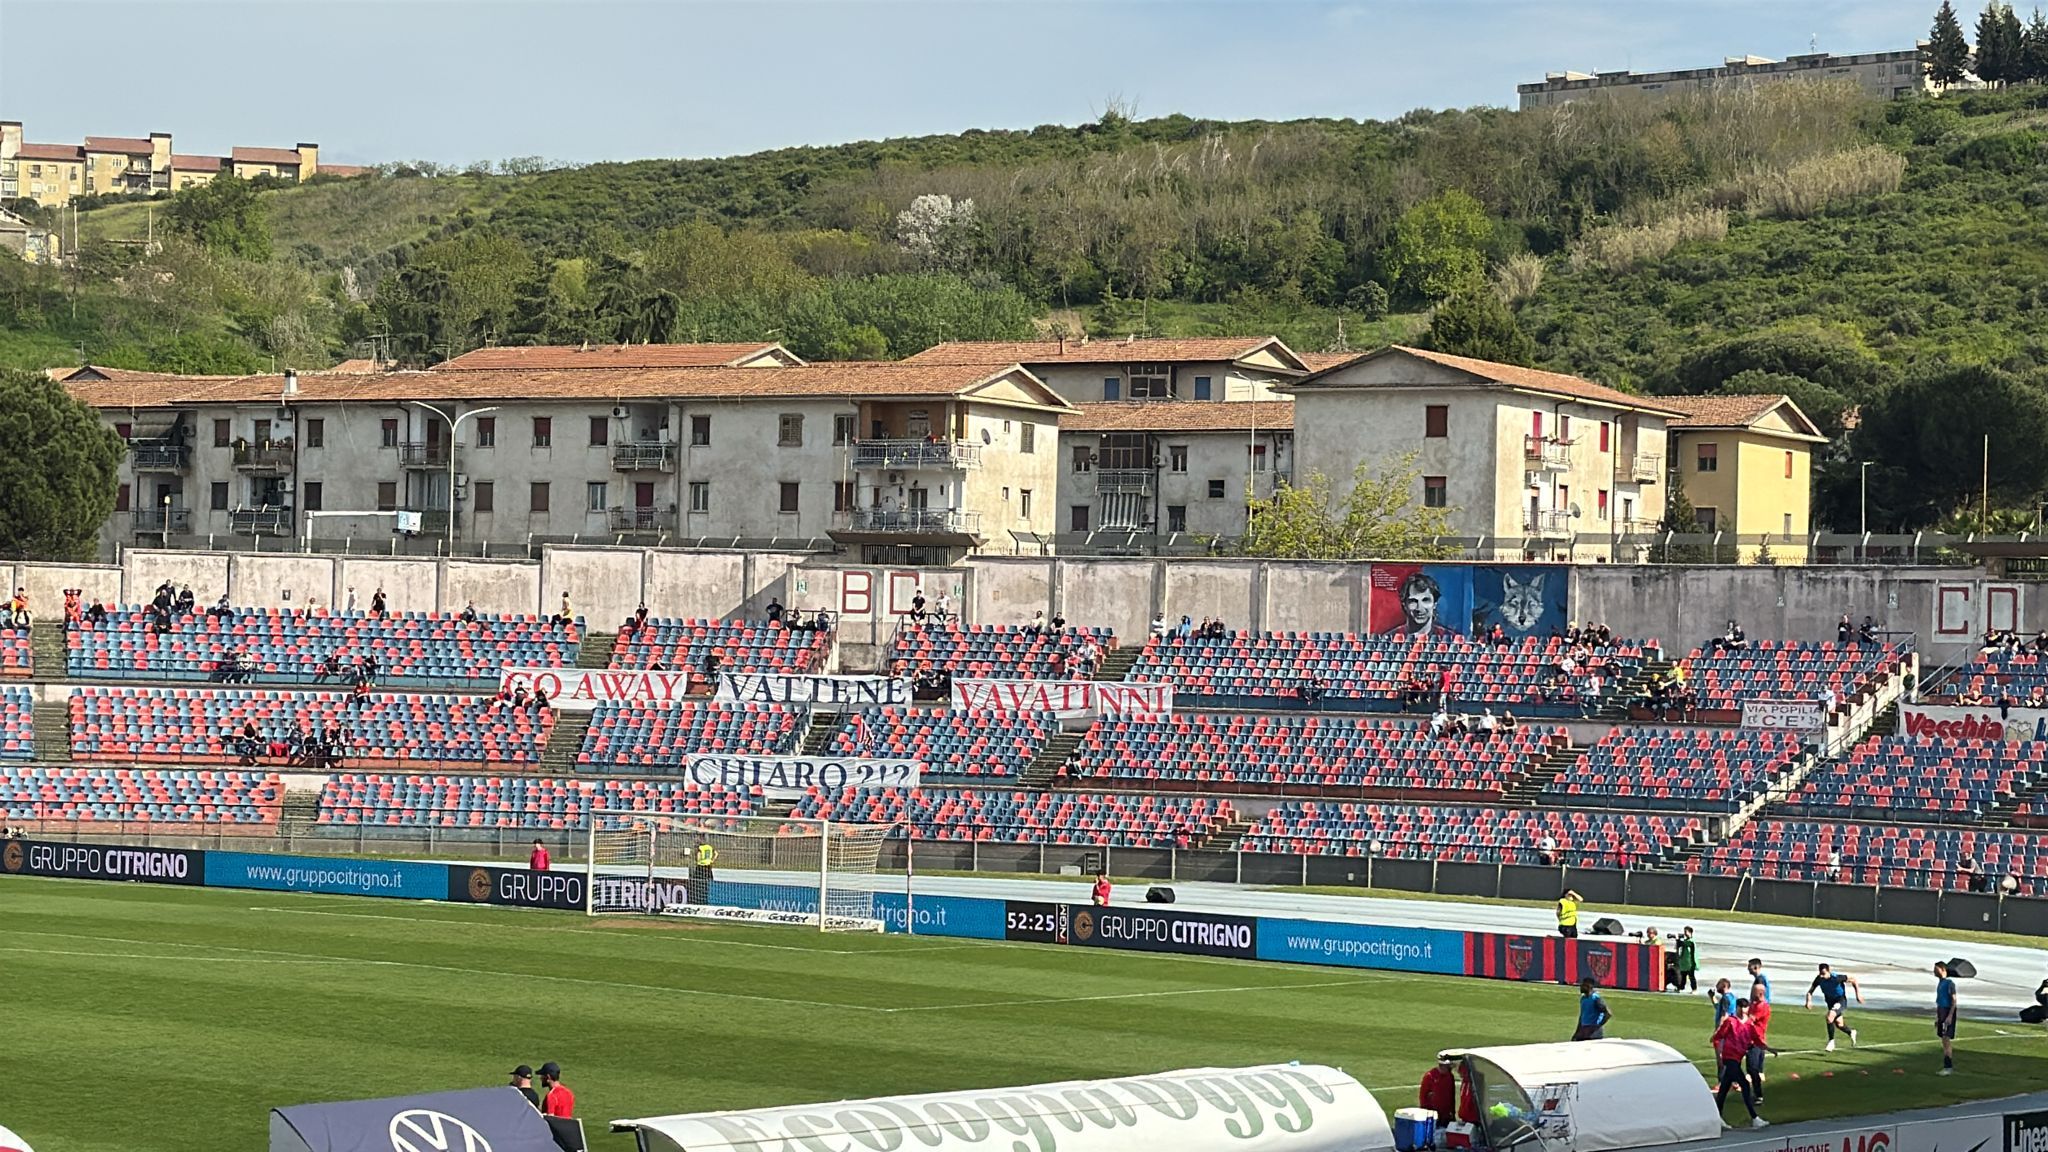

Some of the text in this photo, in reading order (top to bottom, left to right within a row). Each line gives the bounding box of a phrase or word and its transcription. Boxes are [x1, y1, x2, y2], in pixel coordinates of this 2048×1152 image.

[842, 571, 872, 613] B
[889, 572, 919, 614] C
[1938, 587, 1969, 634] C
[504, 672, 684, 702] GO AWAY
[724, 674, 907, 704] VATTENE
[1747, 705, 1767, 713] VIA
[1904, 711, 2004, 742] Vecchia
[691, 758, 910, 788] CHIARO ?!?
[30, 845, 188, 879] GRUPPO CITRIGNO
[247, 865, 402, 891] www.gruppocitrigno.it
[500, 872, 581, 904] GRUPPO
[1007, 911, 1056, 932] 52:25
[1100, 915, 1251, 949] GRUPPO CITRIGNO
[1287, 936, 1432, 960] www.gruppocitrigno.it
